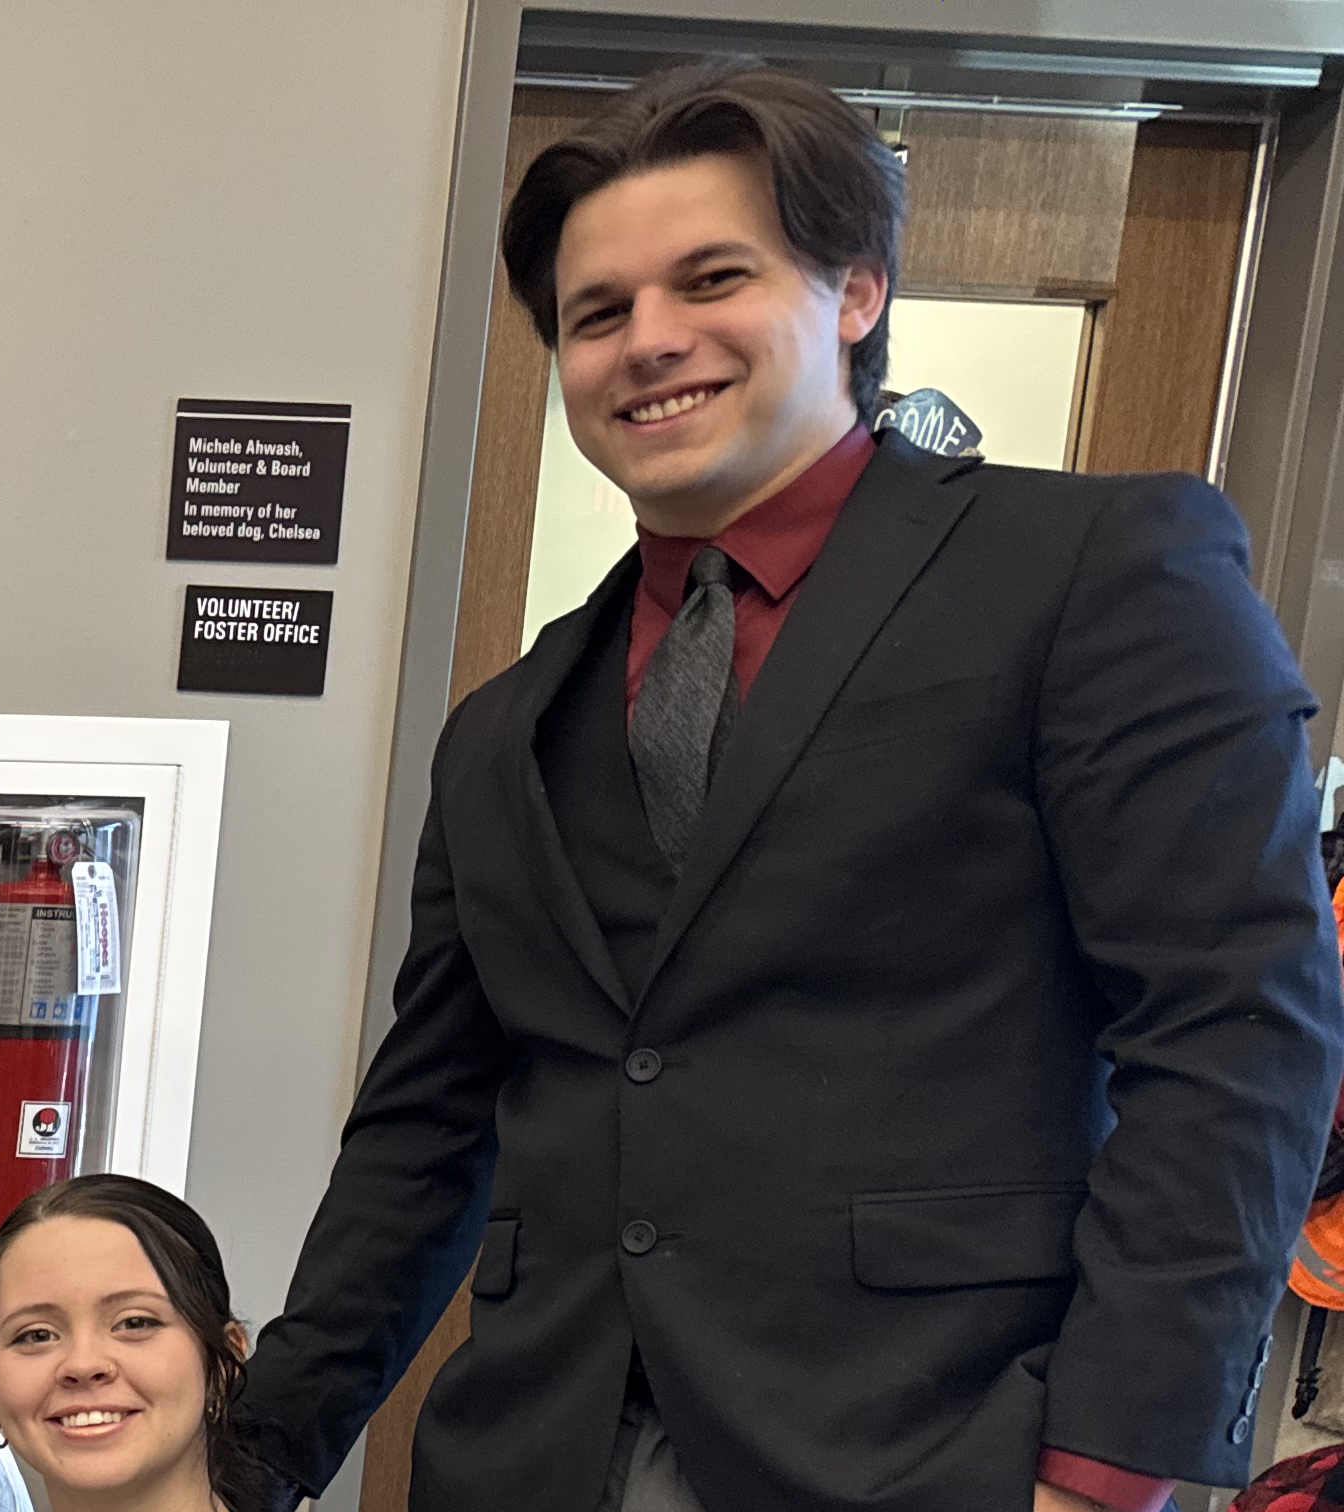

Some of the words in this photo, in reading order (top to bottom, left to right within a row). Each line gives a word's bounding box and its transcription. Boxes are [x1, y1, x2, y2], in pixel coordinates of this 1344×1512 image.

[189, 437, 242, 454] Michele
[245, 439, 303, 458] Ahwash,
[188, 457, 252, 475] Volunteer
[255, 459, 267, 476] &
[270, 460, 311, 477] Board
[185, 477, 240, 494] Member
[184, 500, 197, 517] In
[200, 504, 254, 521] memory
[257, 503, 272, 519] of
[274, 503, 297, 519] her
[182, 519, 234, 537] beloved
[237, 521, 265, 541] dog,
[268, 523, 321, 540] Chelsea
[197, 597, 300, 622] VOLUNTEER/
[194, 620, 258, 642] FOSTER
[263, 622, 320, 644] OFFICE
[36, 908, 75, 919] INSTRU
